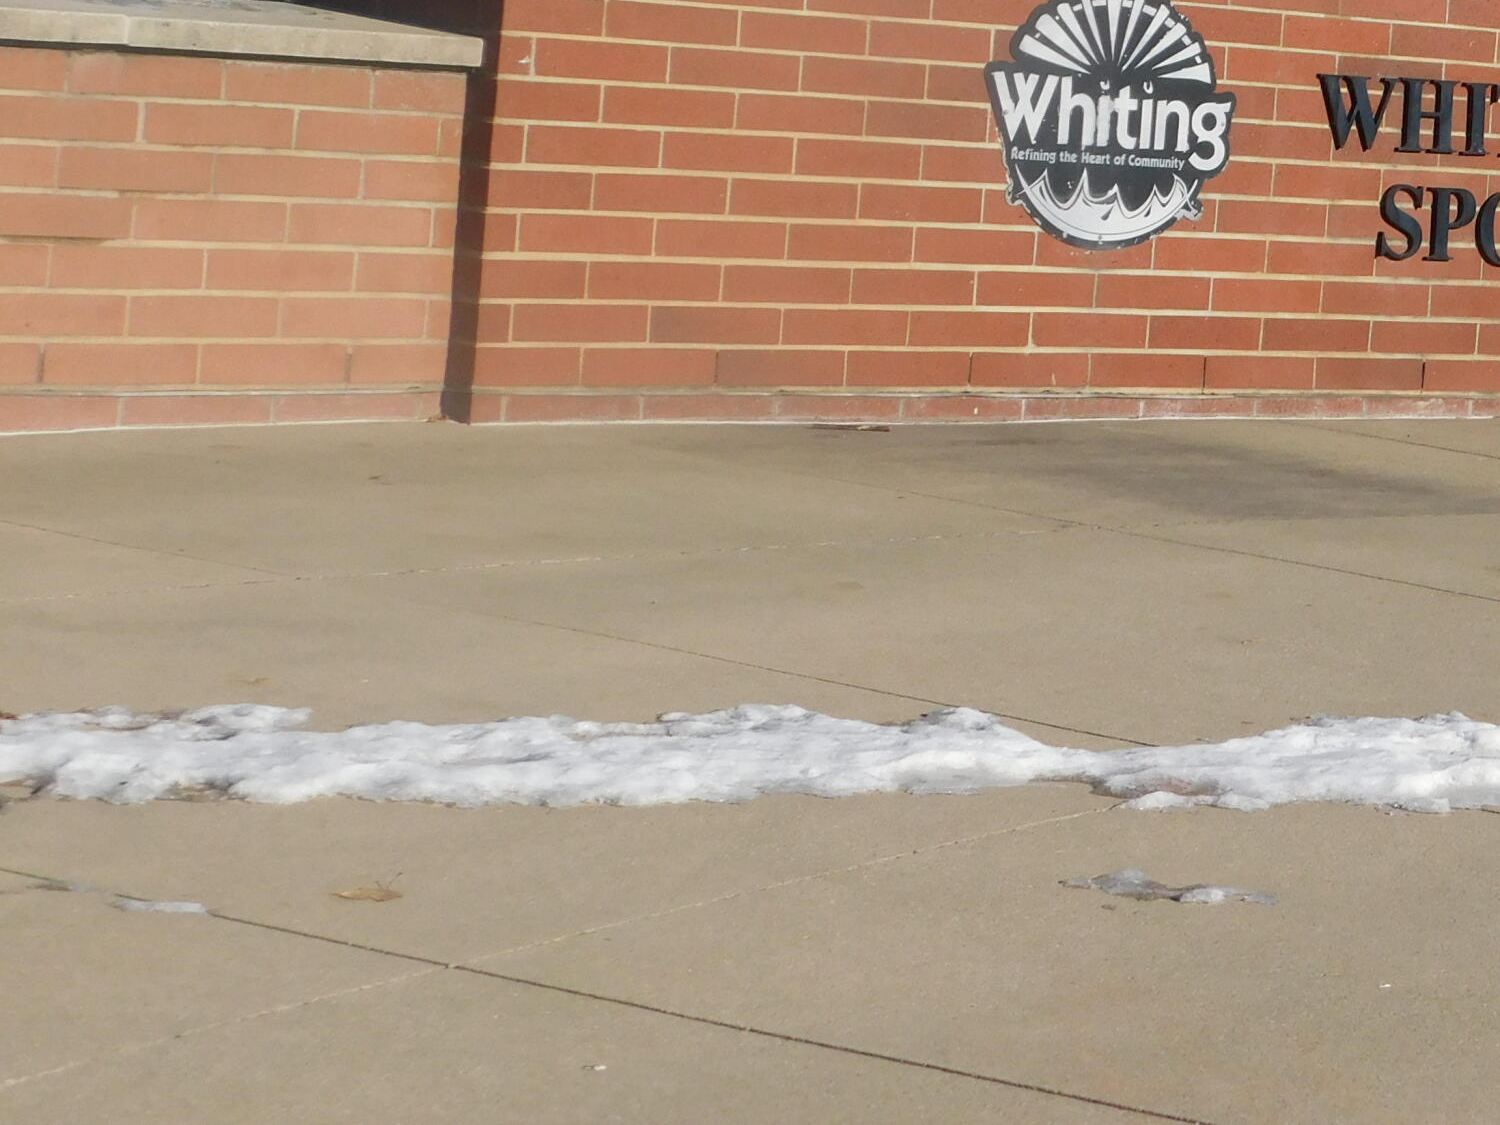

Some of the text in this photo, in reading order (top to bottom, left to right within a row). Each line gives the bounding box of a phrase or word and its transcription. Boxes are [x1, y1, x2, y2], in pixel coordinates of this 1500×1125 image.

[991, 71, 1232, 171] Whiting
[1010, 146, 1185, 171] Refining the Heart of Community
